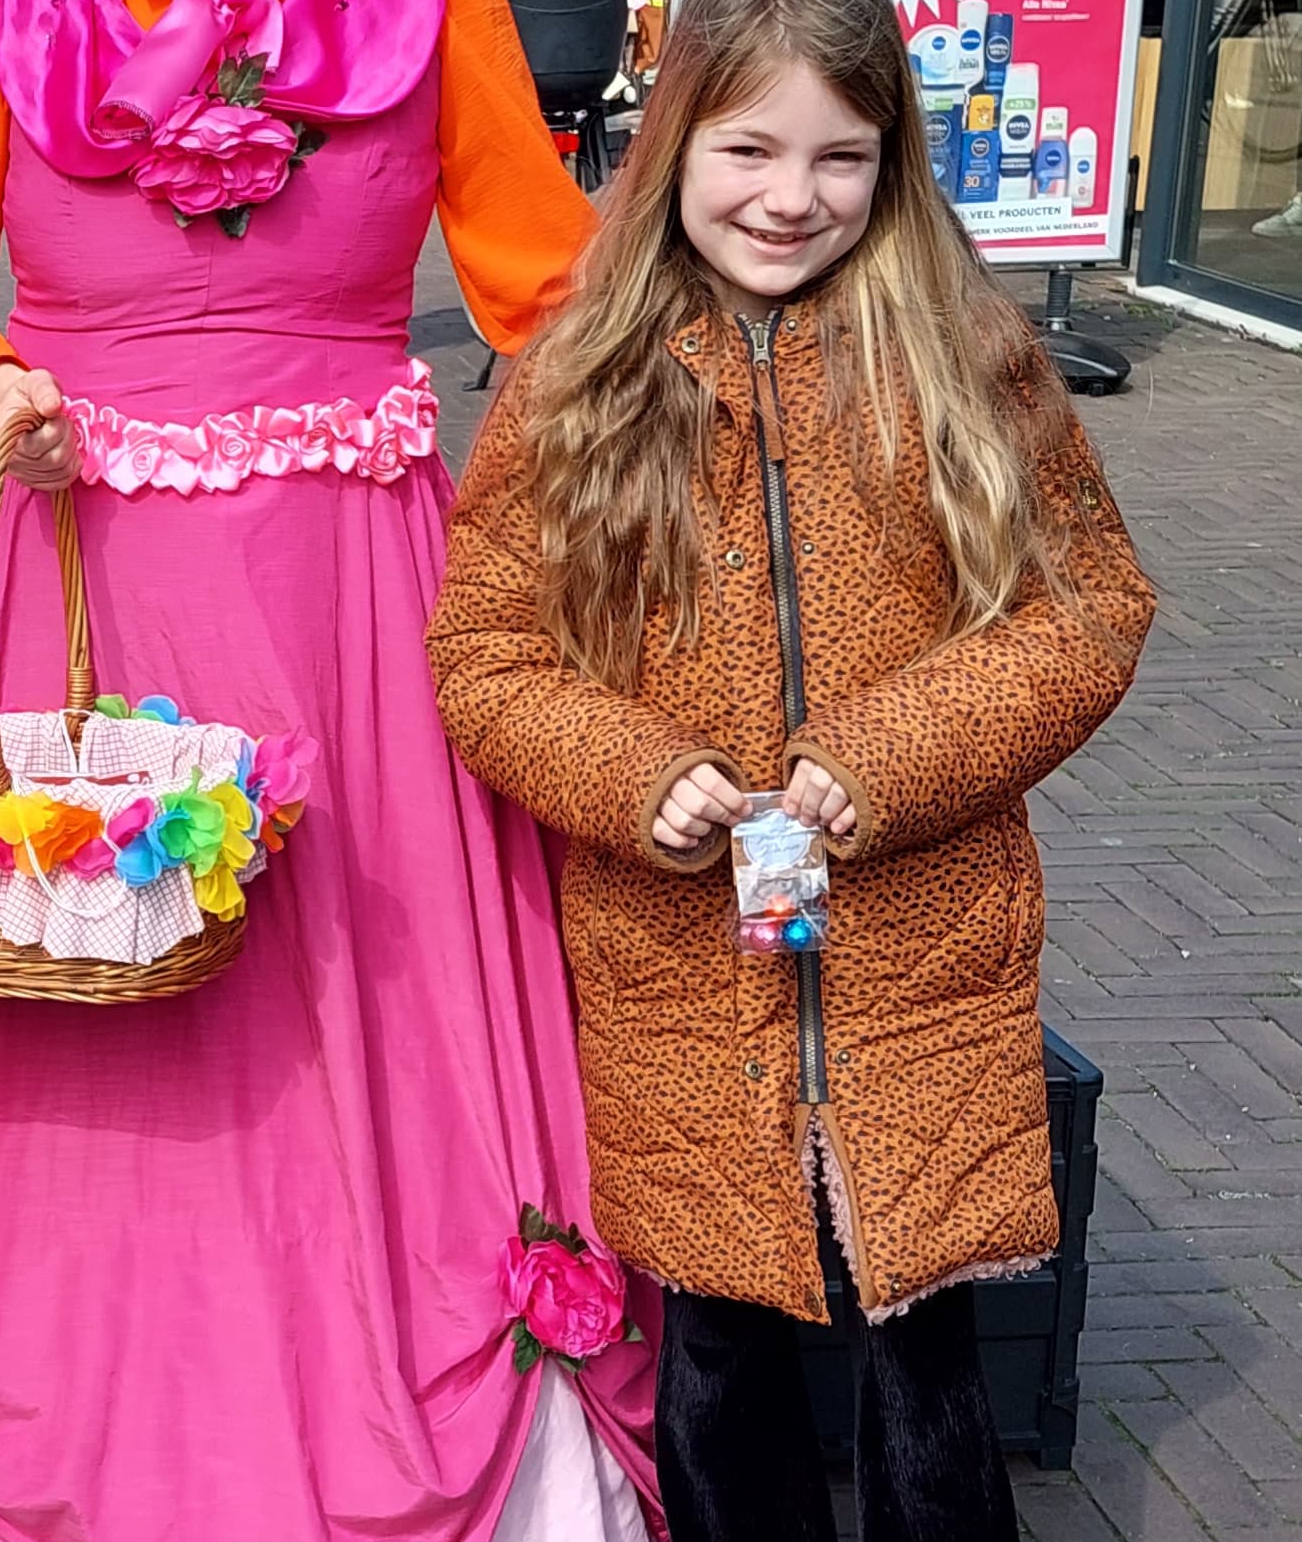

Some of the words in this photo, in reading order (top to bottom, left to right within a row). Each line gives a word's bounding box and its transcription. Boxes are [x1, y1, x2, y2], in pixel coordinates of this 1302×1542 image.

[964, 176, 980, 188] 30
[969, 210, 996, 220] VEEL
[998, 206, 1062, 219] PRODUCTEN
